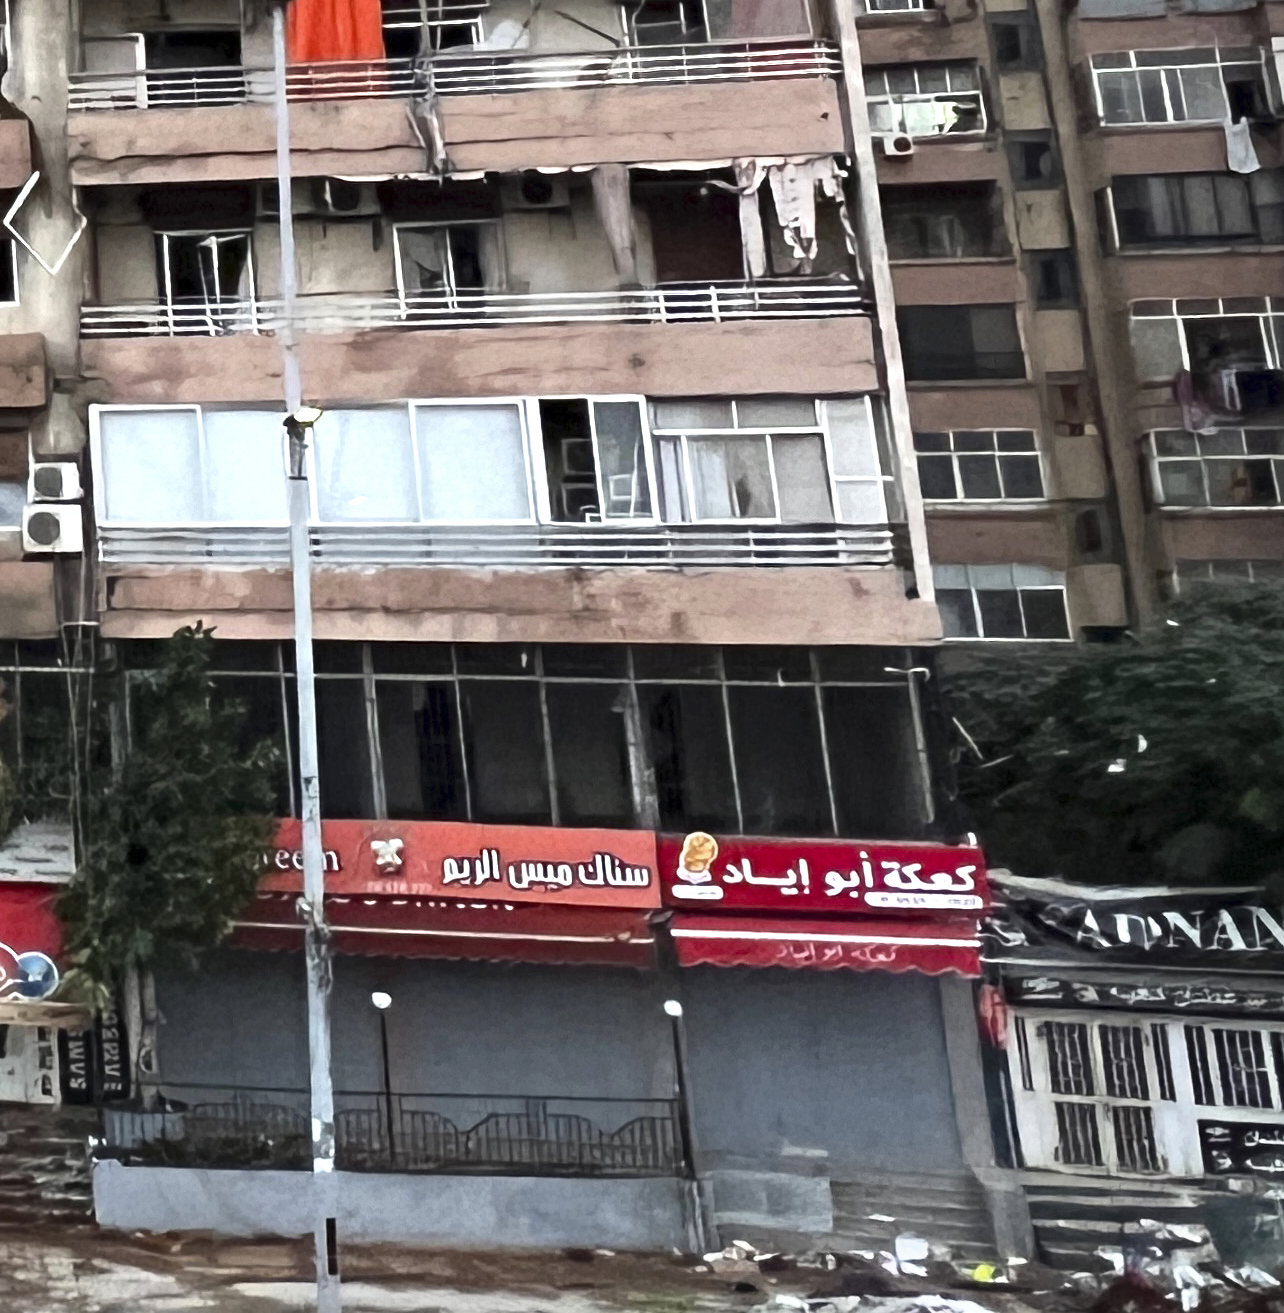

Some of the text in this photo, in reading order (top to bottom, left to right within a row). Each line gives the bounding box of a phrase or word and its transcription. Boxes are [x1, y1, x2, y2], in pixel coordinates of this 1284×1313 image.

[442, 848, 649, 891] سناك ميس الريم
[722, 850, 977, 898] كعكة أبو إياد
